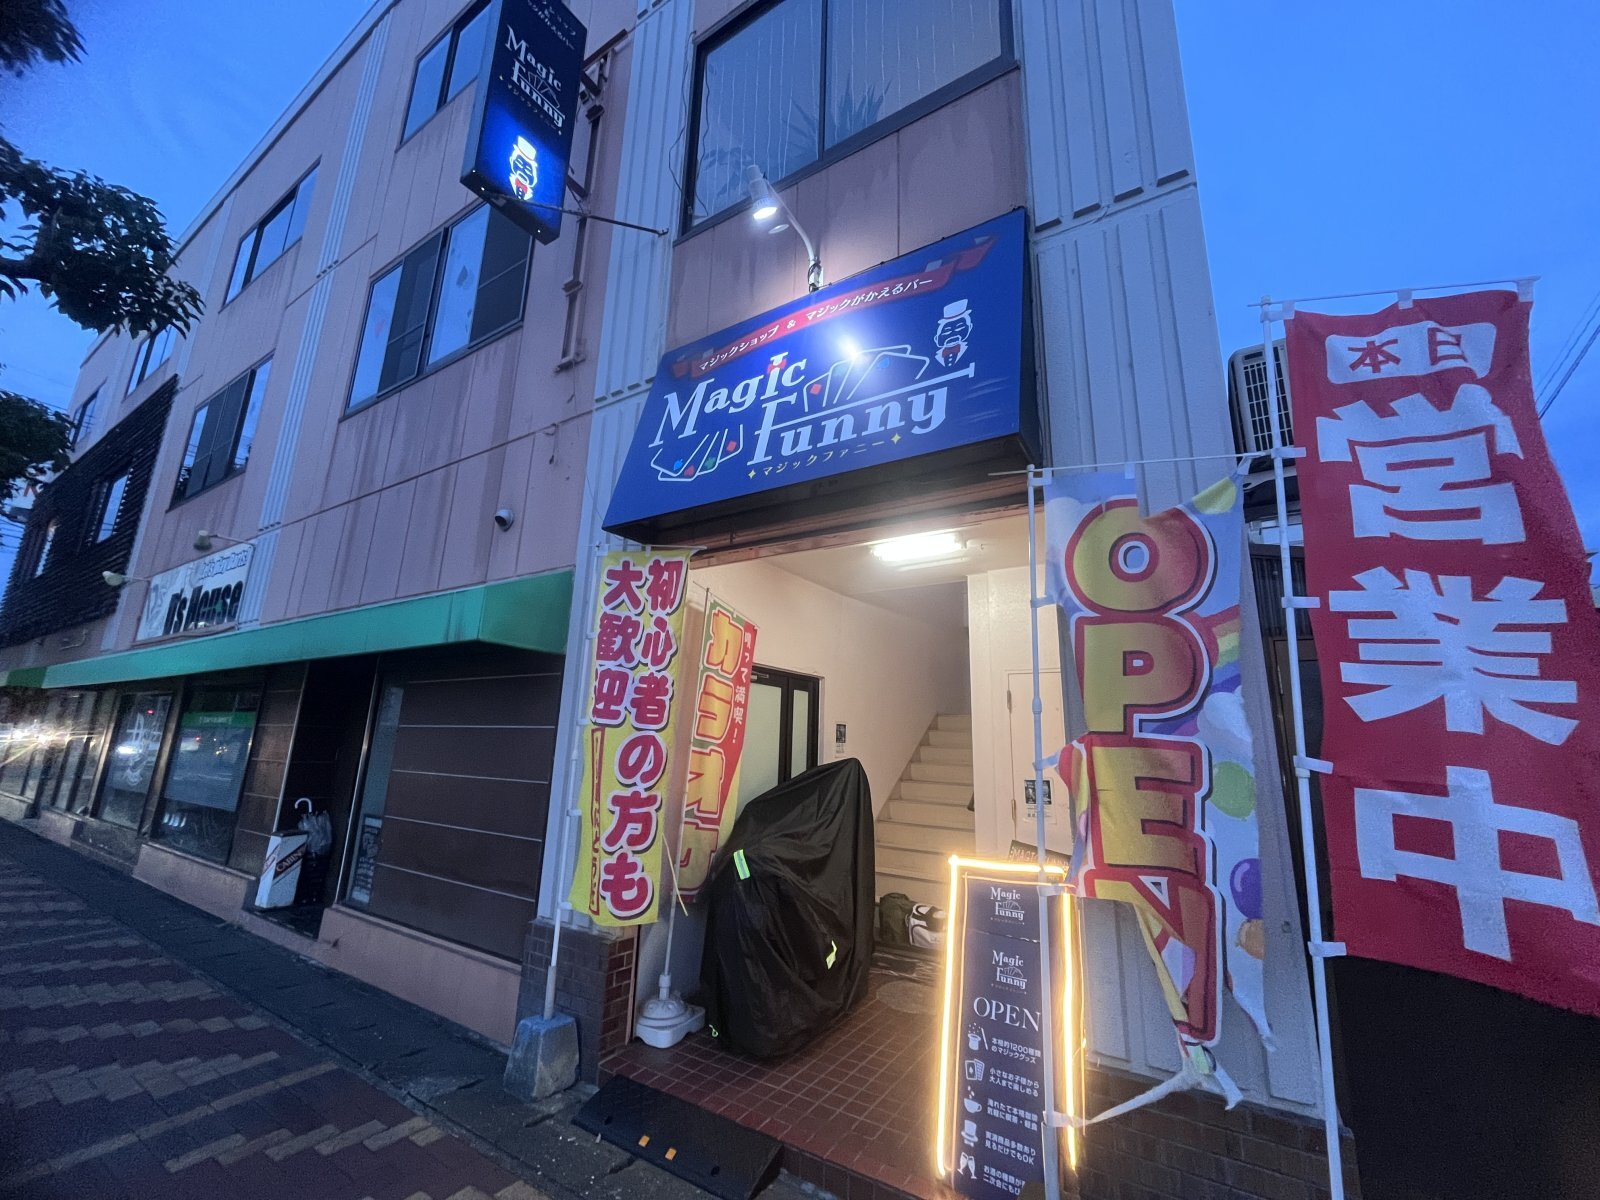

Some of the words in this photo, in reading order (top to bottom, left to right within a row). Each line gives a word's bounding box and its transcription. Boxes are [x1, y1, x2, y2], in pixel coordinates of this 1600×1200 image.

[505, 25, 562, 92] Magic
[512, 59, 566, 127] Funny
[699, 327, 779, 371] マジックショップ
[787, 319, 797, 328] &
[805, 279, 934, 321] マジックがかえるバー
[1347, 327, 1469, 374] 本日
[648, 351, 808, 448] Magic
[746, 362, 975, 466] Funny
[763, 439, 884, 477] マジックファニー
[183, 580, 244, 631] House
[592, 560, 643, 723] 大歓迎
[1316, 384, 1600, 962] 営業中
[602, 559, 684, 914] 初心者の方も
[990, 887, 1021, 901] Magic
[995, 902, 1025, 921] Funny
[992, 950, 1024, 967] Magic
[996, 967, 1028, 990] Funny
[973, 996, 1041, 1032] OPEN
[989, 1067, 1040, 1089] 小さなお子様から
[991, 1046, 1036, 1064] のマジックグッズ
